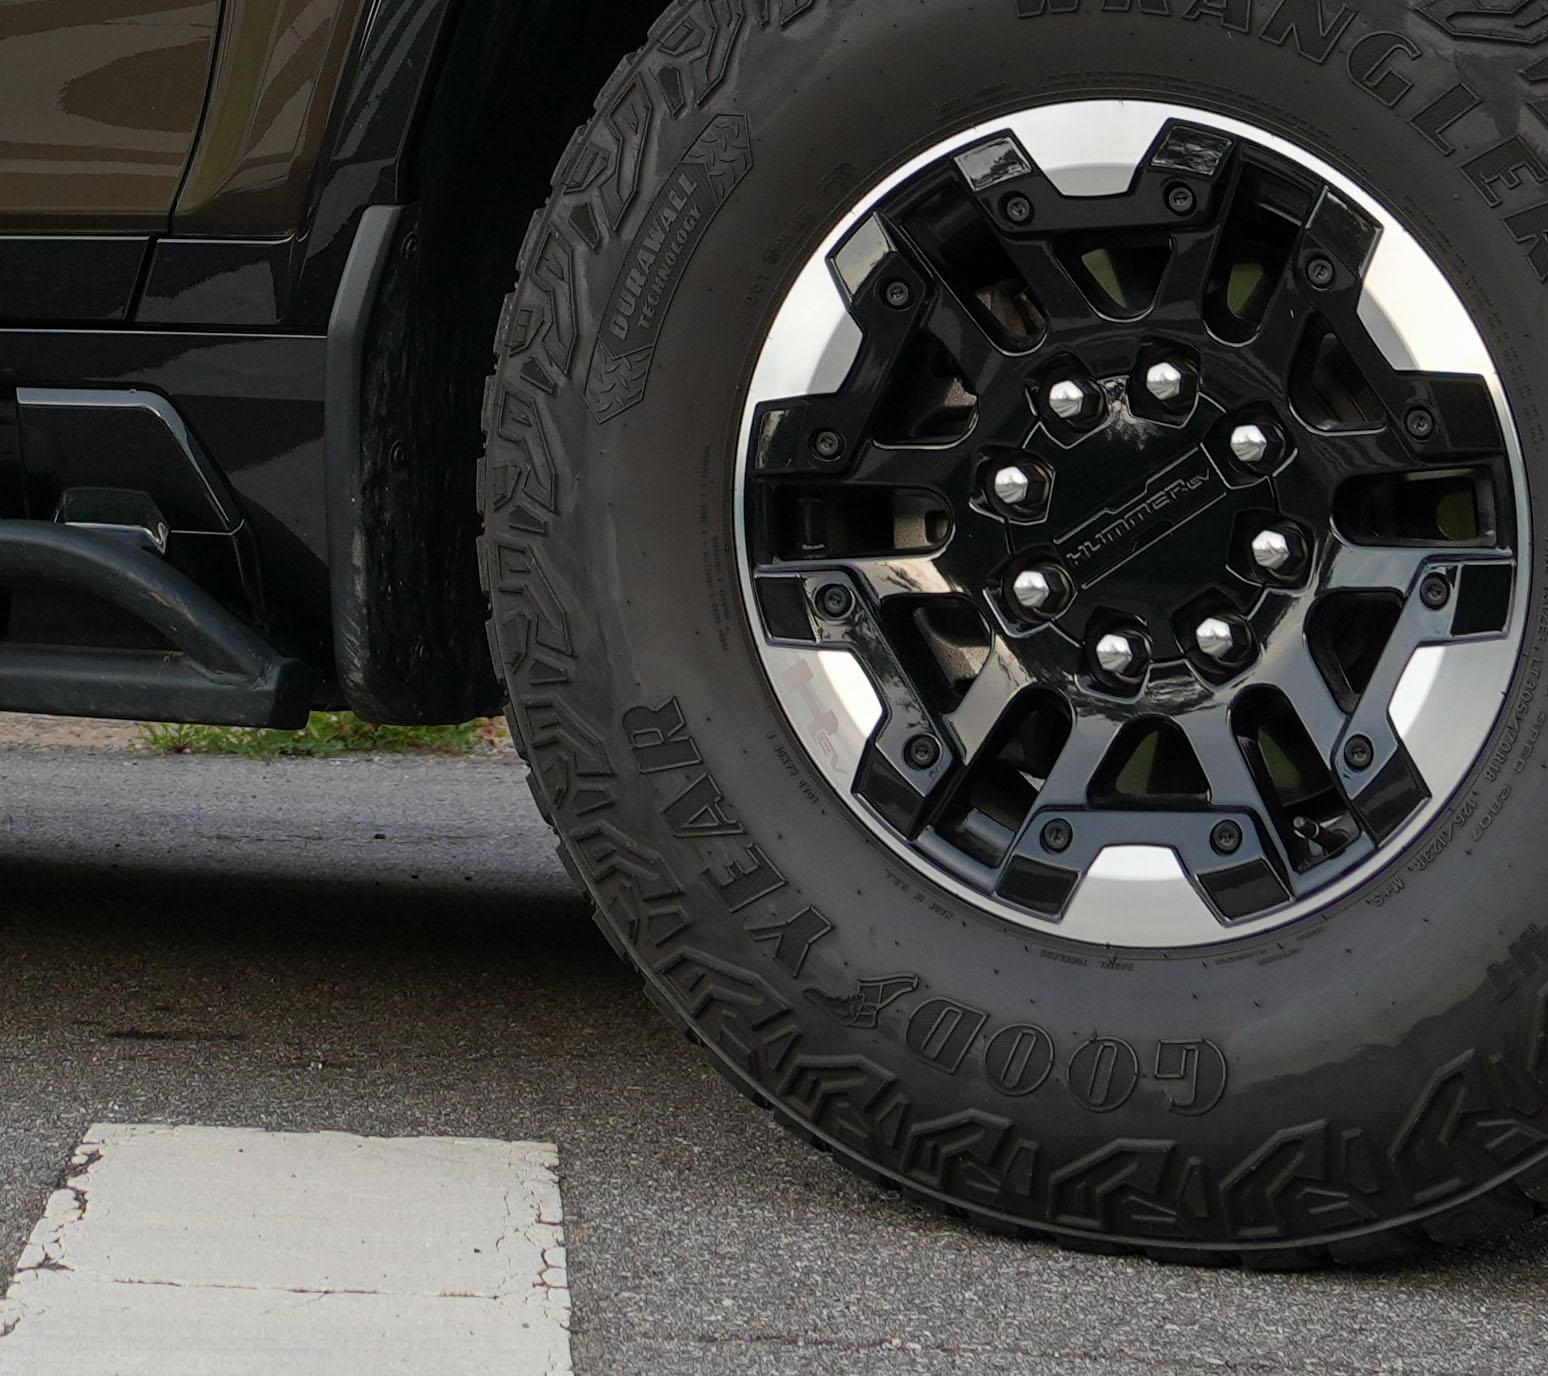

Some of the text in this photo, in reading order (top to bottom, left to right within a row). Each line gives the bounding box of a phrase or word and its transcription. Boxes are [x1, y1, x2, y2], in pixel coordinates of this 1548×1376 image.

[609, 174, 698, 340] DURAWALL
[637, 205, 702, 329] TECHNOLOGY
[1066, 479, 1185, 566] HUMMER
[620, 694, 1232, 1116] GOODYEAR
